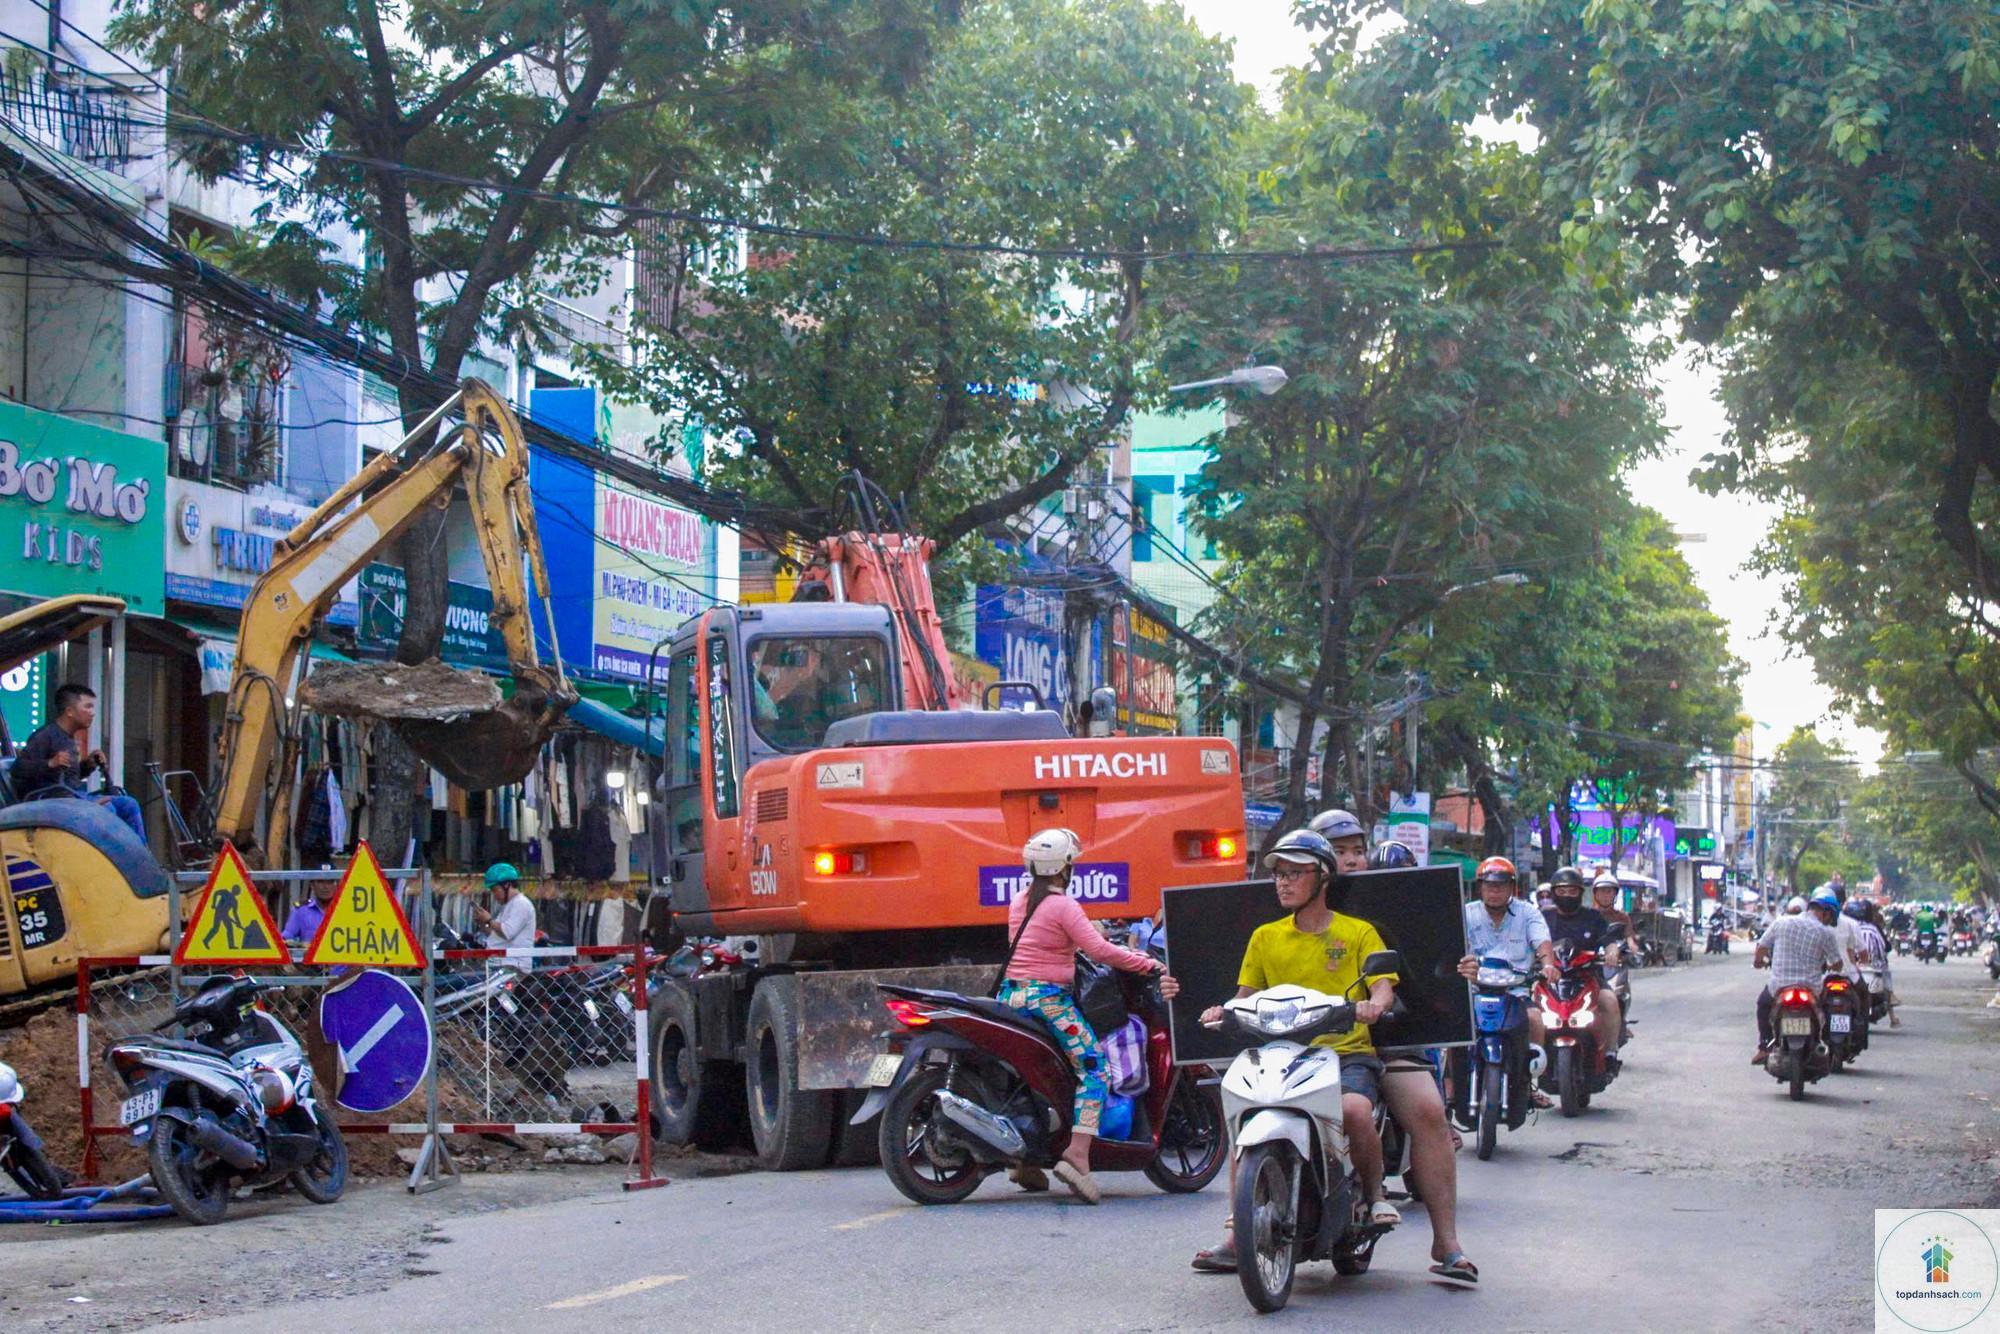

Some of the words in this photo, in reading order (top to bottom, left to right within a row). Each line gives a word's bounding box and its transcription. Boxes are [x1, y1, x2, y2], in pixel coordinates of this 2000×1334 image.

[66, 456, 149, 524] Mơ
[24, 521, 103, 570] KIDS
[212, 526, 273, 575] TRUN
[1034, 752, 1168, 779] HITACHI
[17, 896, 38, 912] PC
[352, 886, 375, 913] ĐI
[20, 911, 48, 931] 35
[24, 931, 46, 945] MR
[330, 921, 399, 961] CHẬM
